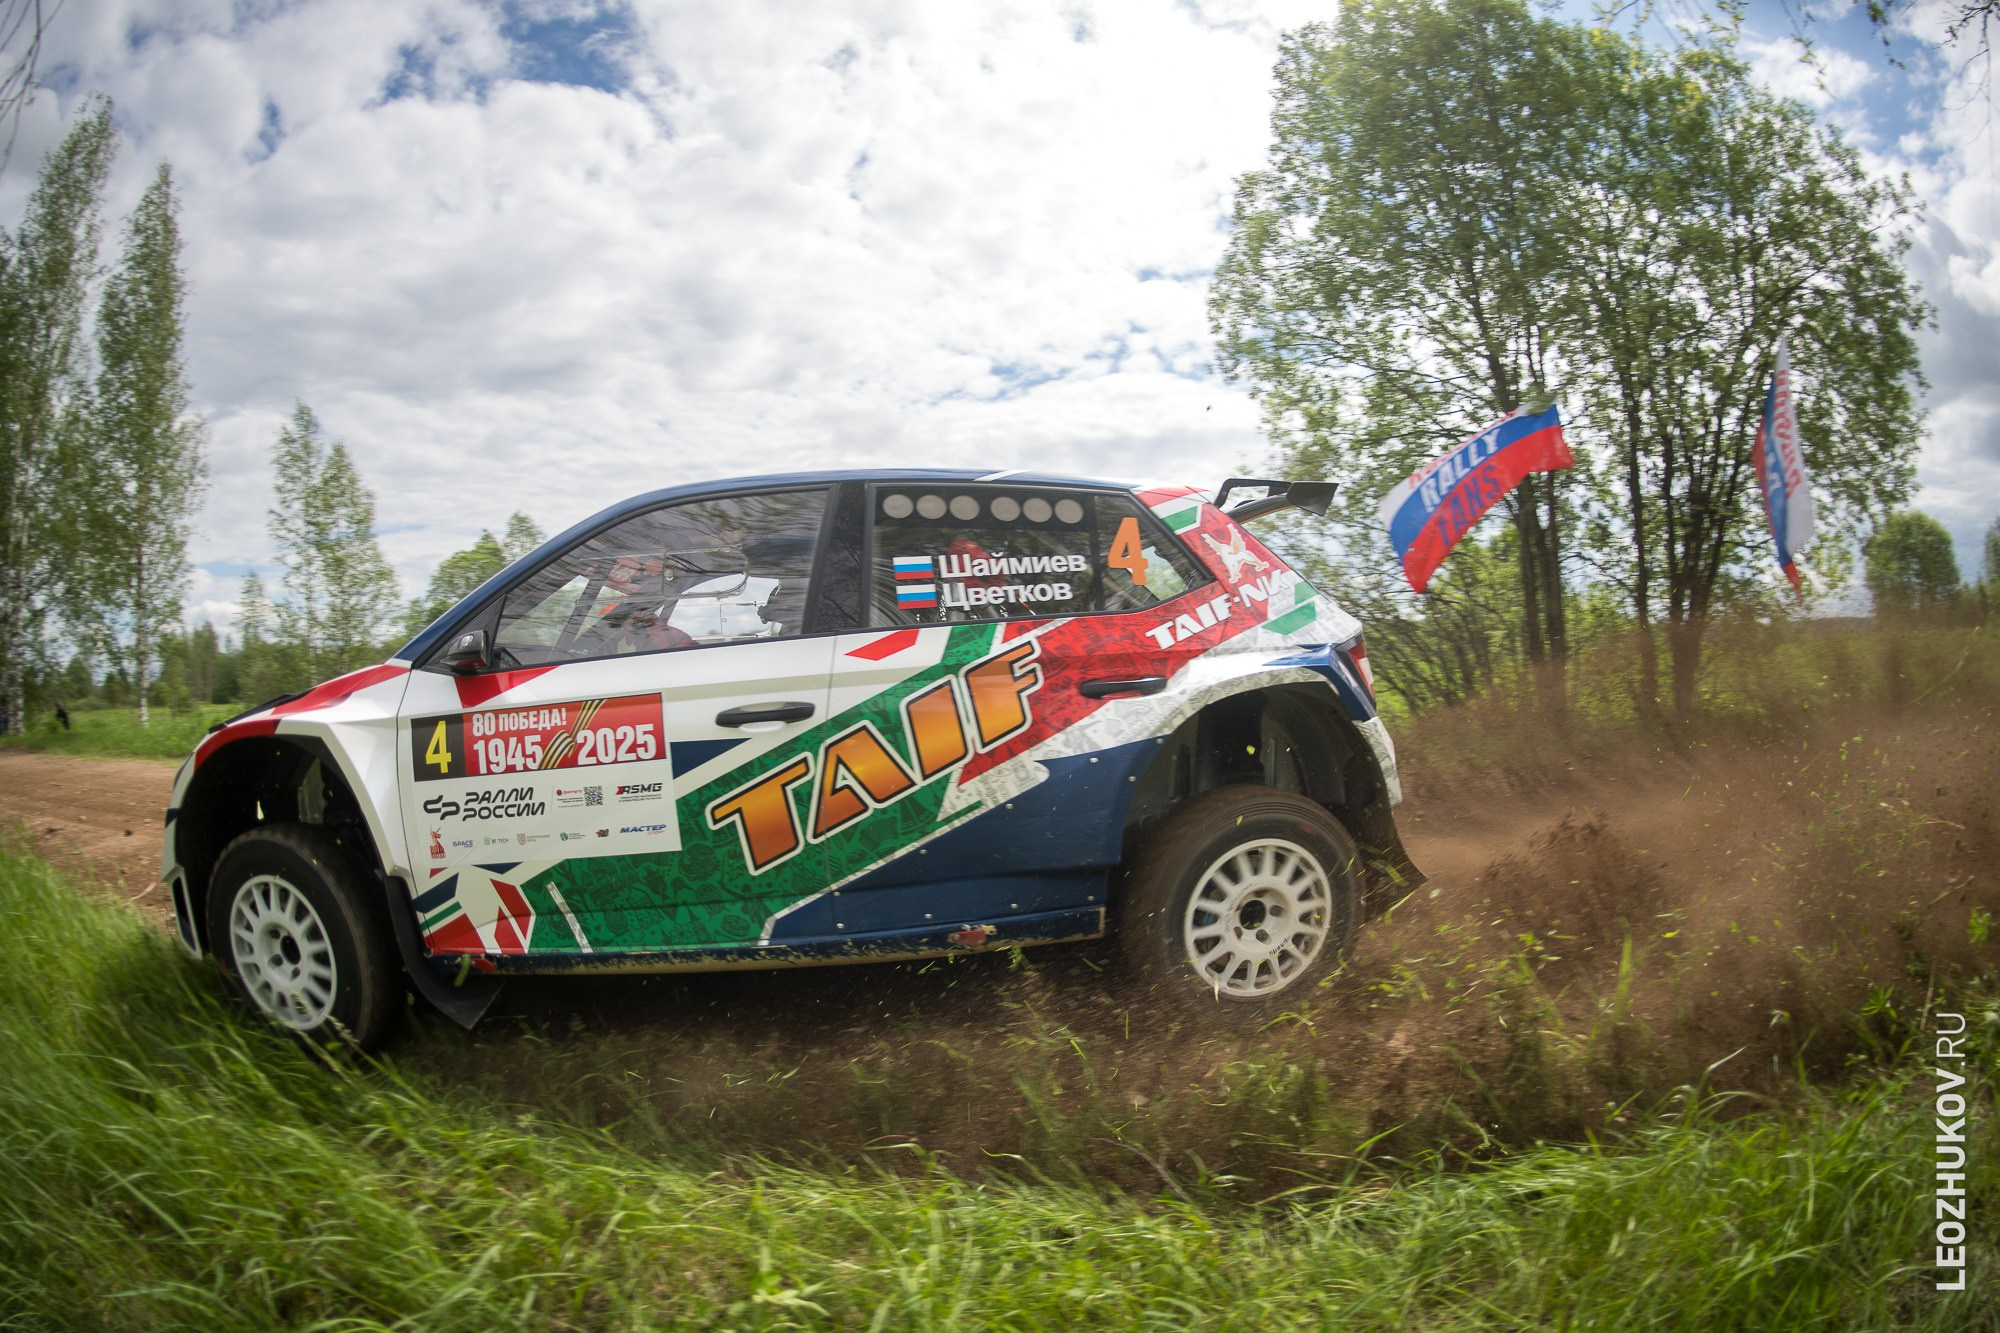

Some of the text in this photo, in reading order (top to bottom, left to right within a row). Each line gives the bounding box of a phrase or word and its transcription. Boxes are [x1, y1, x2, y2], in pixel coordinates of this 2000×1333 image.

[1419, 429, 1500, 513] RALLY
[1437, 465, 1501, 548] FANS
[938, 551, 1088, 579] Шаймиев
[1107, 517, 1149, 586] 4
[942, 582, 1074, 611] Цветков
[472, 707, 567, 736] 80 ПОБЕДА!
[425, 720, 452, 774] 4
[473, 724, 657, 774] 1945 2025
[705, 637, 1044, 876] TAIF
[462, 802, 545, 821] РОССИИ
[466, 787, 533, 805] РАЛЛИ
[620, 824, 667, 834] МАСТЕР
